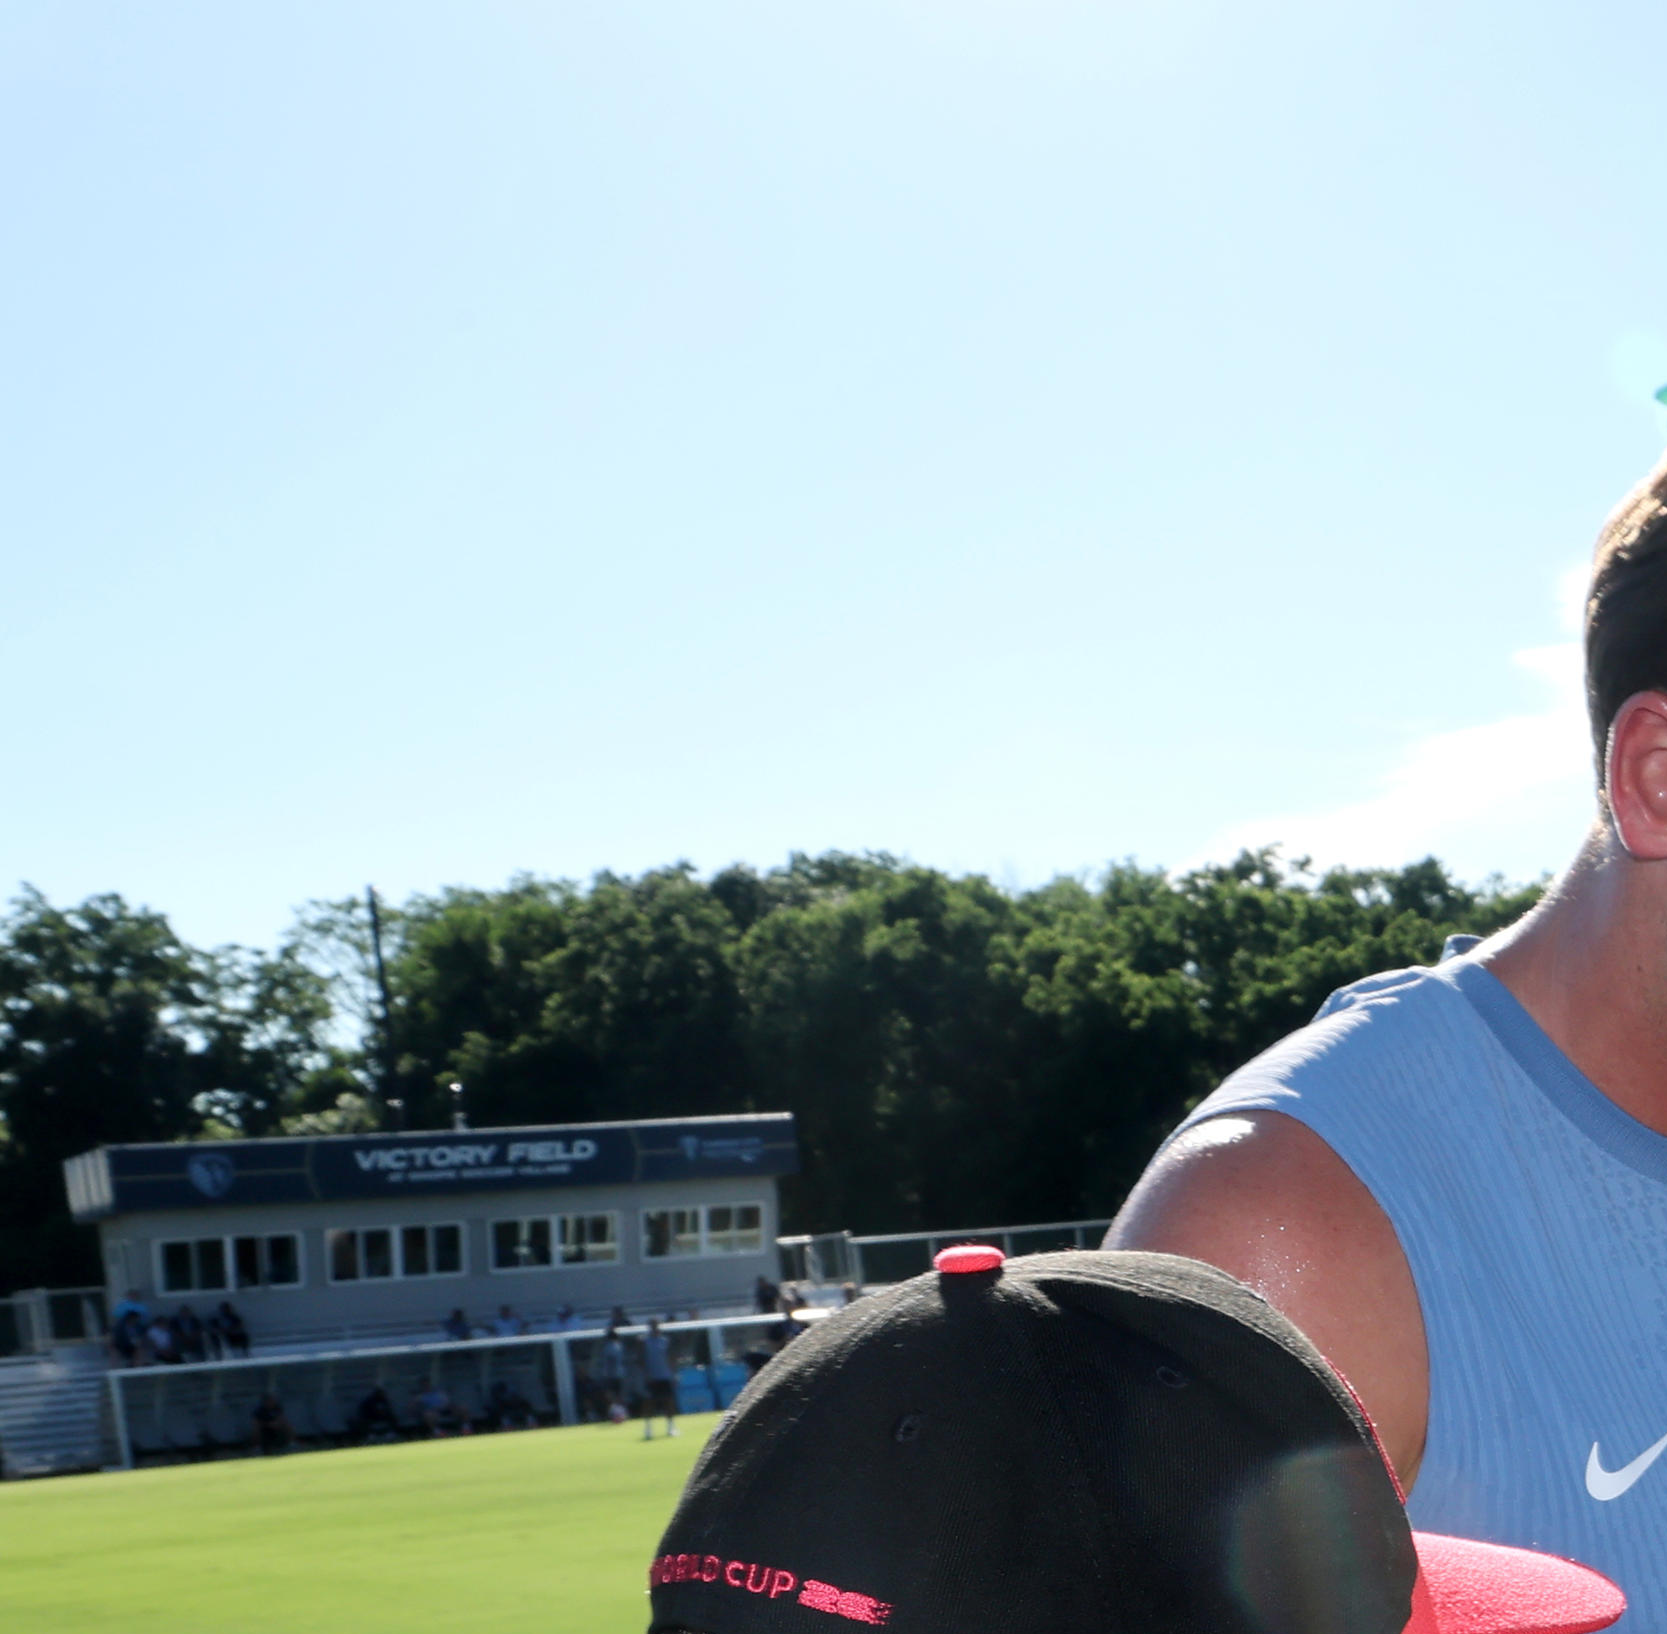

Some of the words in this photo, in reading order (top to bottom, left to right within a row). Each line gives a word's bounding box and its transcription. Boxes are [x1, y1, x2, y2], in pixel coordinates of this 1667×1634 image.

[354, 1144, 497, 1171] VICTORY
[507, 1140, 598, 1162] FIELD
[723, 1559, 798, 1599] CUP
